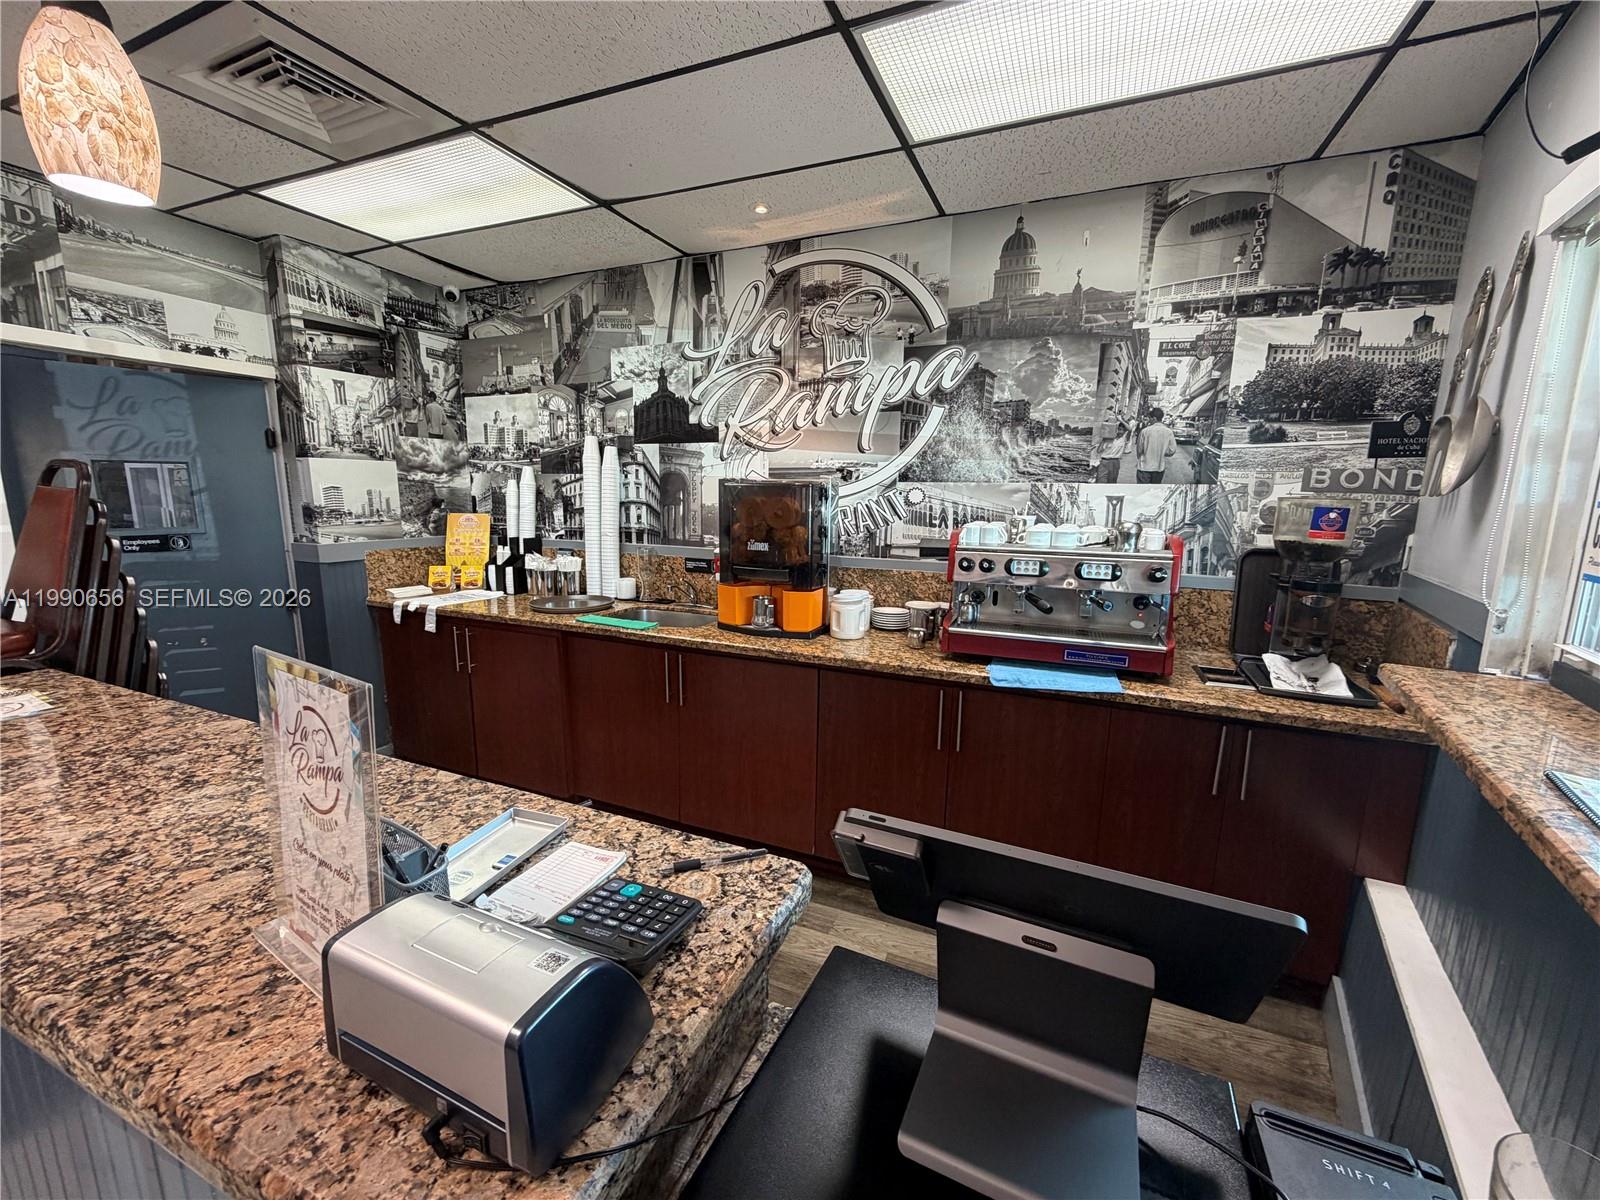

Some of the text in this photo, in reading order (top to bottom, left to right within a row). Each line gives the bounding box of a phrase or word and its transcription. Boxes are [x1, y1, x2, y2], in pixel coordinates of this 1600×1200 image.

[682, 280, 799, 403] La
[699, 345, 977, 461] Rampa
[286, 710, 309, 750] La
[290, 747, 344, 797] Rampa
[1321, 1158, 1391, 1190] SHIFT 4
